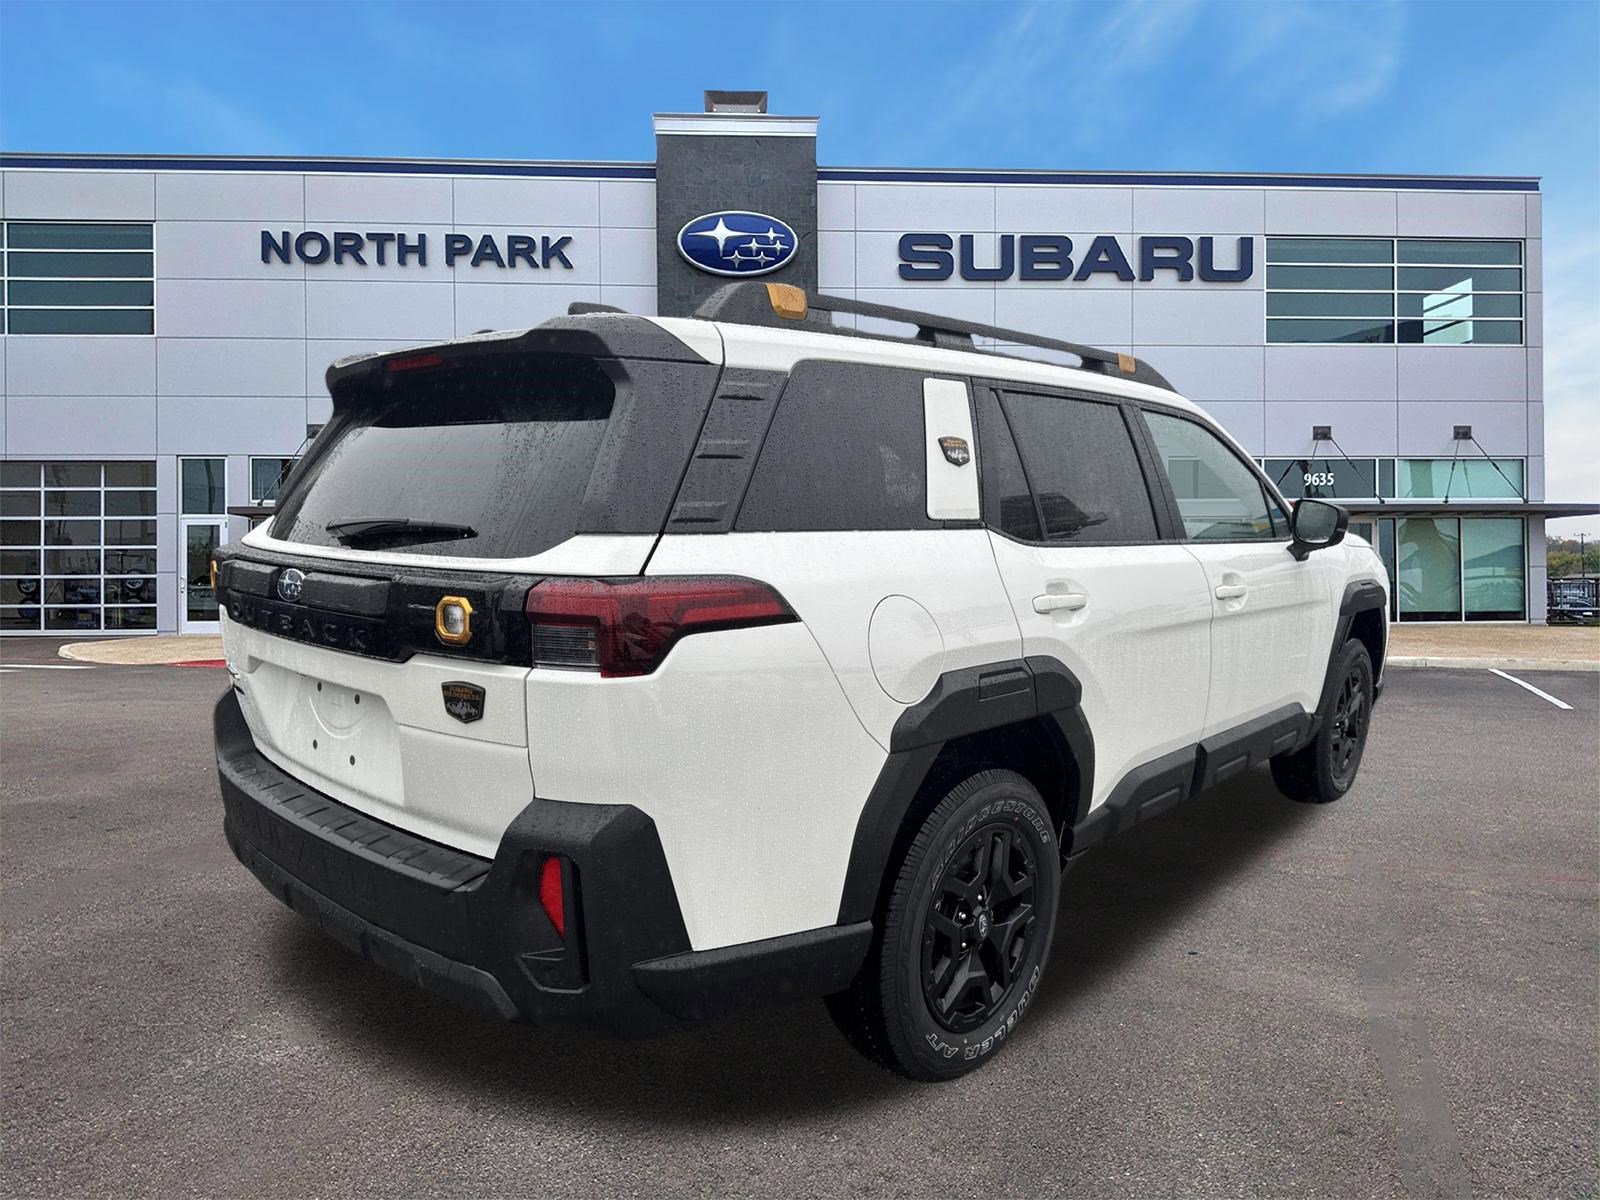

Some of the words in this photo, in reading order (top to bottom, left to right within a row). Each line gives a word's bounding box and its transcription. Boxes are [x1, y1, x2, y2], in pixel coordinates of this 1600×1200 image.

[261, 230, 427, 267] NORTH
[445, 233, 574, 270] PARK
[898, 232, 1254, 283] SUBARU
[1303, 472, 1335, 487] 9635
[231, 601, 369, 650] OUTBACK
[931, 800, 1052, 892] BRIDGESTONE
[925, 1033, 959, 1059] A/T
